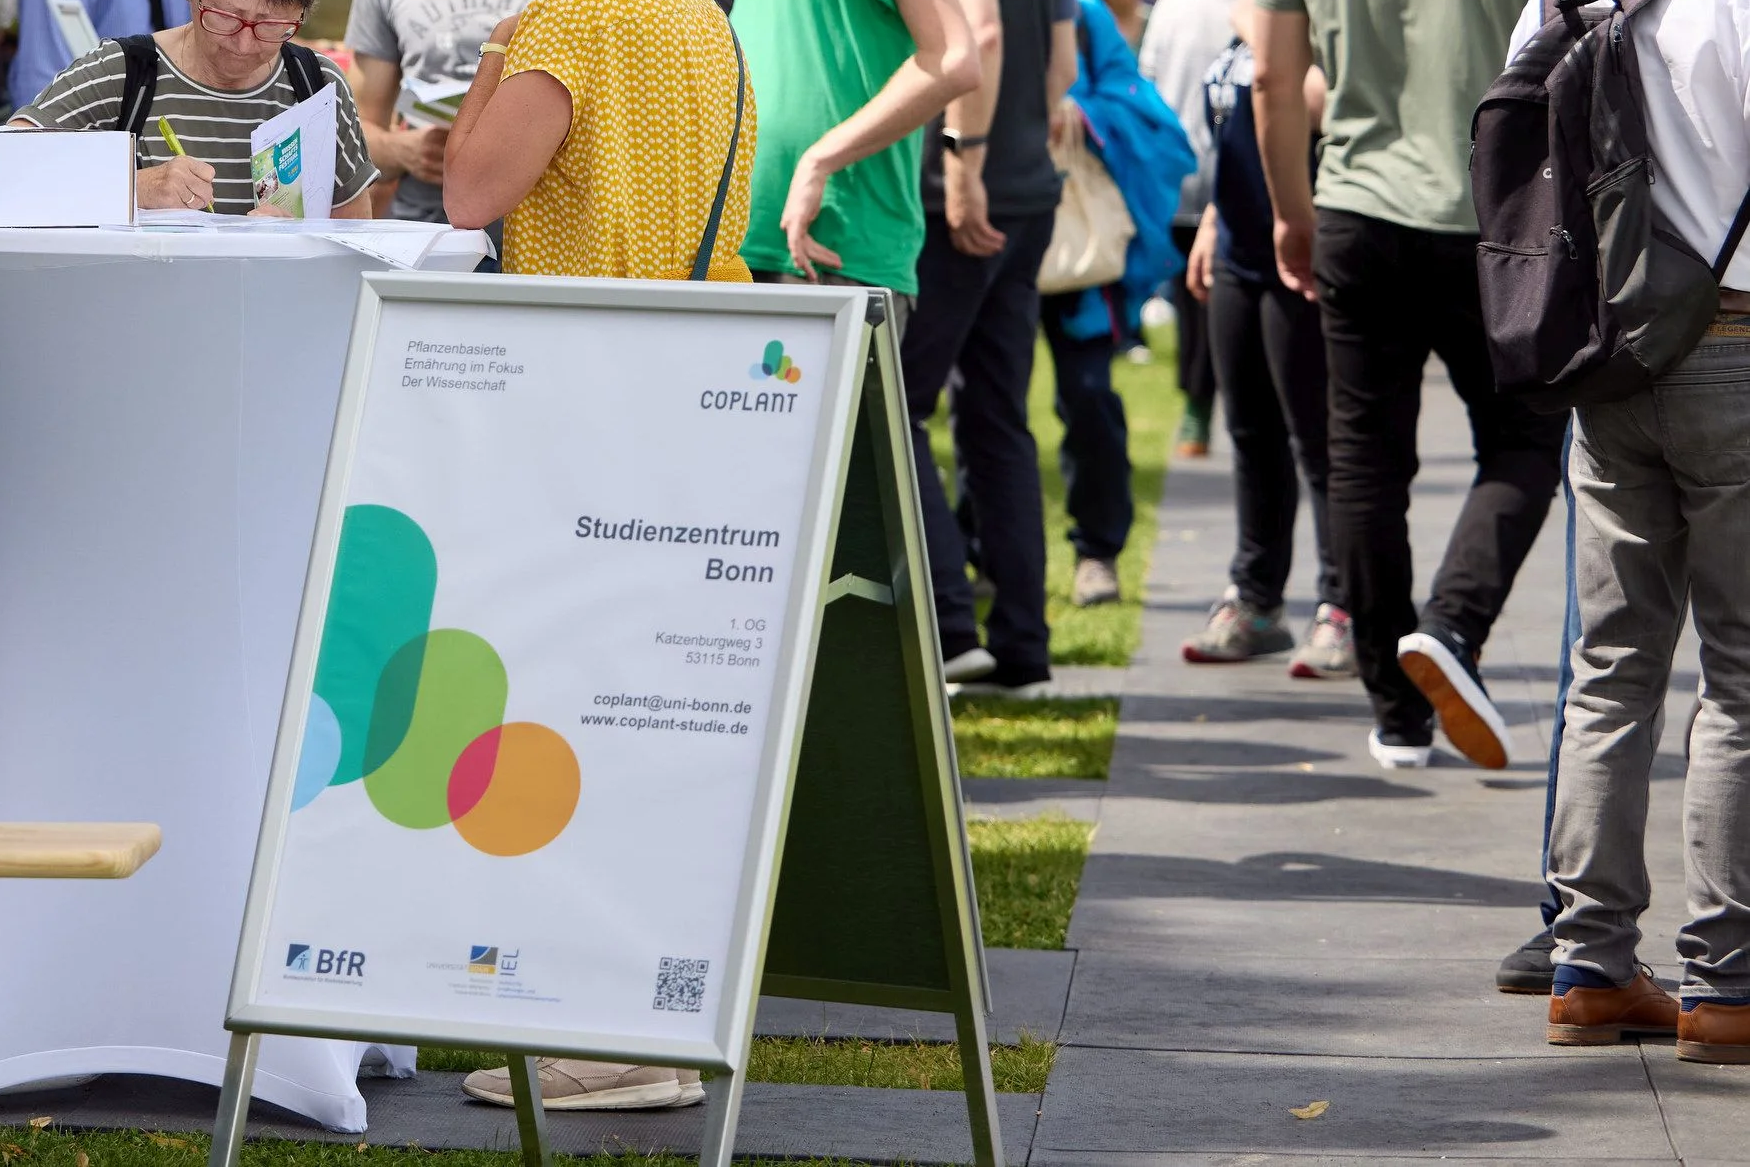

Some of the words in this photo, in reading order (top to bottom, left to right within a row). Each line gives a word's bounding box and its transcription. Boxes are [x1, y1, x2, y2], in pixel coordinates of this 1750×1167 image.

[407, 340, 506, 356] Pflanzenbasierte
[404, 357, 467, 374] Ernährung
[470, 361, 484, 373] im
[488, 361, 524, 374] Fokus
[402, 375, 423, 388] Der
[426, 376, 506, 391] Wissenschaft
[700, 389, 798, 413] COPLANT
[575, 515, 780, 547] Studienzentrum
[705, 558, 774, 583] Bonn
[730, 618, 740, 630] 1.
[744, 619, 766, 631] OG
[655, 632, 751, 651] Katzenburgweg
[755, 637, 763, 649] 3
[685, 651, 724, 665] 53115
[727, 653, 760, 667] Bonn
[593, 693, 752, 714] coplant@uni-bonn.de
[581, 714, 748, 735] www.coplant-studie.de
[316, 948, 366, 977] BfR
